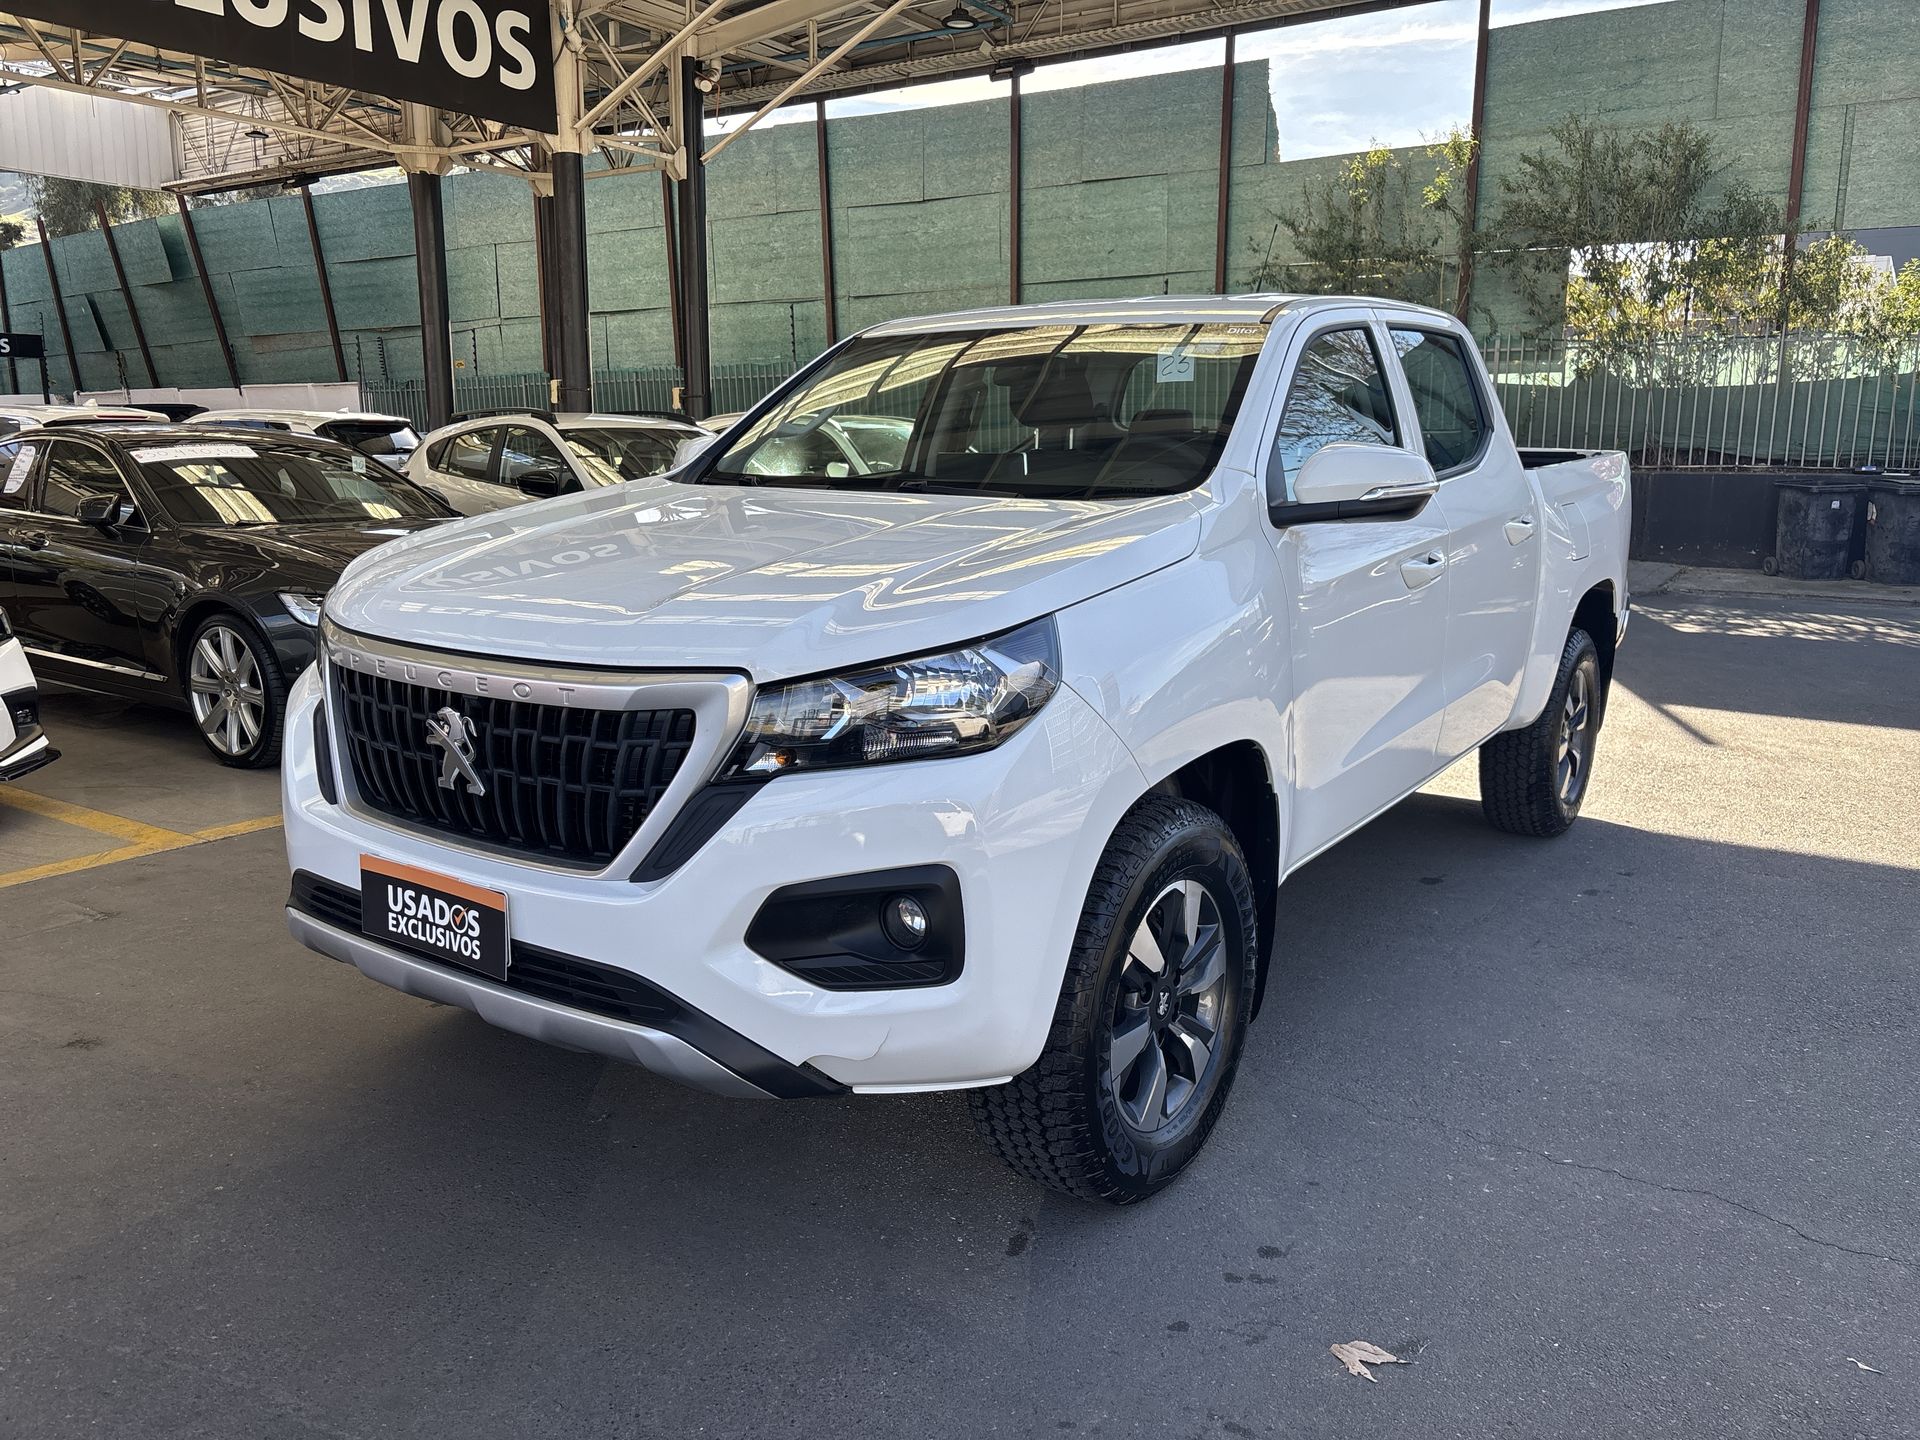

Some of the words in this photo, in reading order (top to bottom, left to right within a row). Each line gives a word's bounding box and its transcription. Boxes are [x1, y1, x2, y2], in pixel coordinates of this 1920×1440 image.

[349, 652, 576, 705] PEUGEOT
[387, 884, 481, 938] USADOS
[388, 911, 481, 960] EXCLUSIVOS
